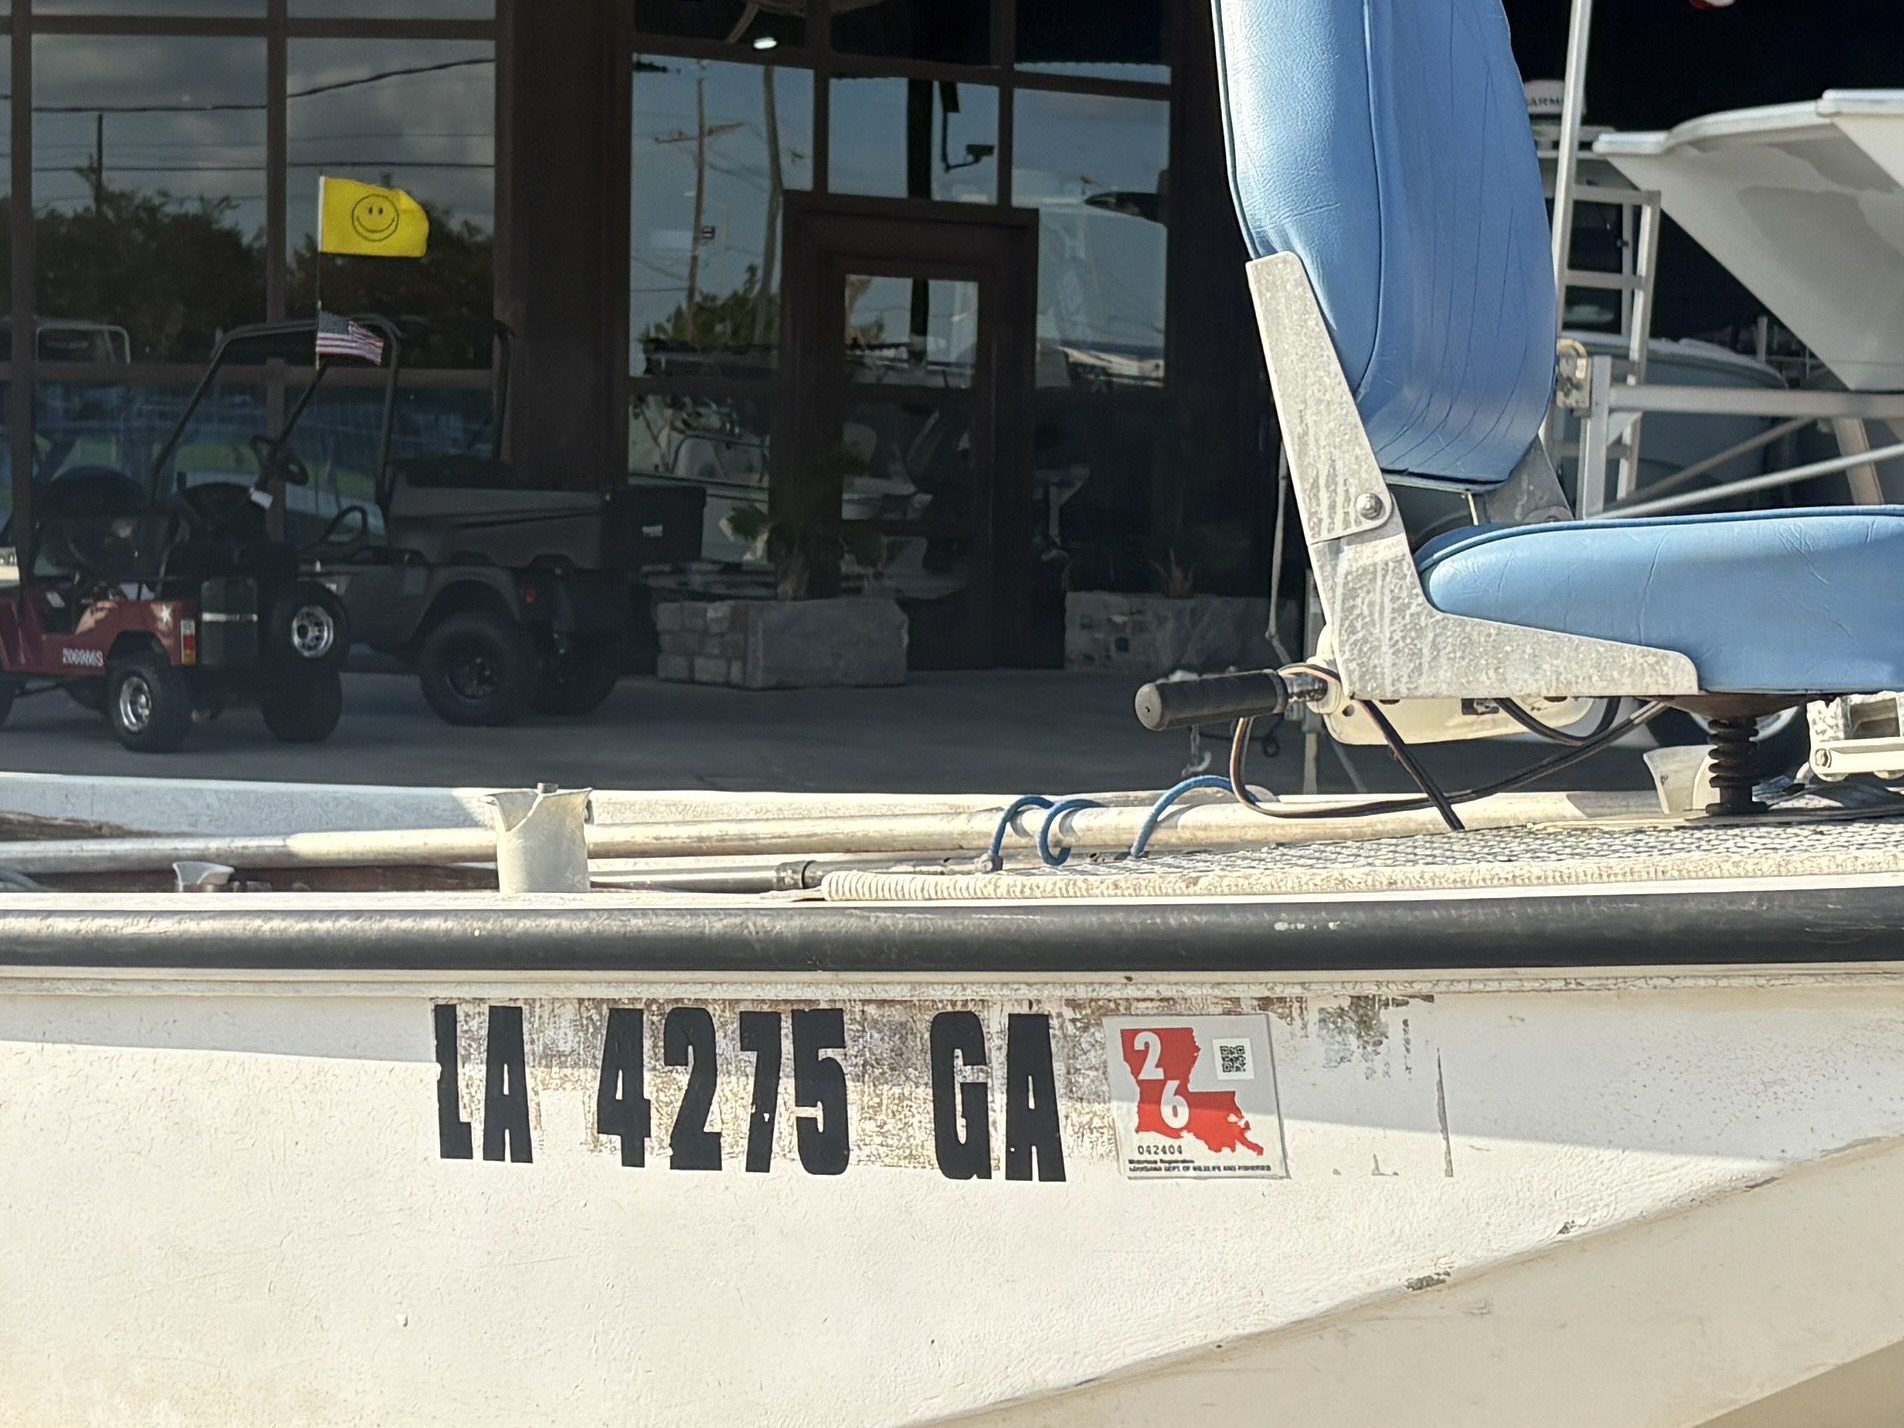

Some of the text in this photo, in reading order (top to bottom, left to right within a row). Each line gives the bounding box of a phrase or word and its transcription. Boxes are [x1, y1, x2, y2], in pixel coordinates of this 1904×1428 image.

[434, 1004, 1067, 1183] LA 4275 GA
